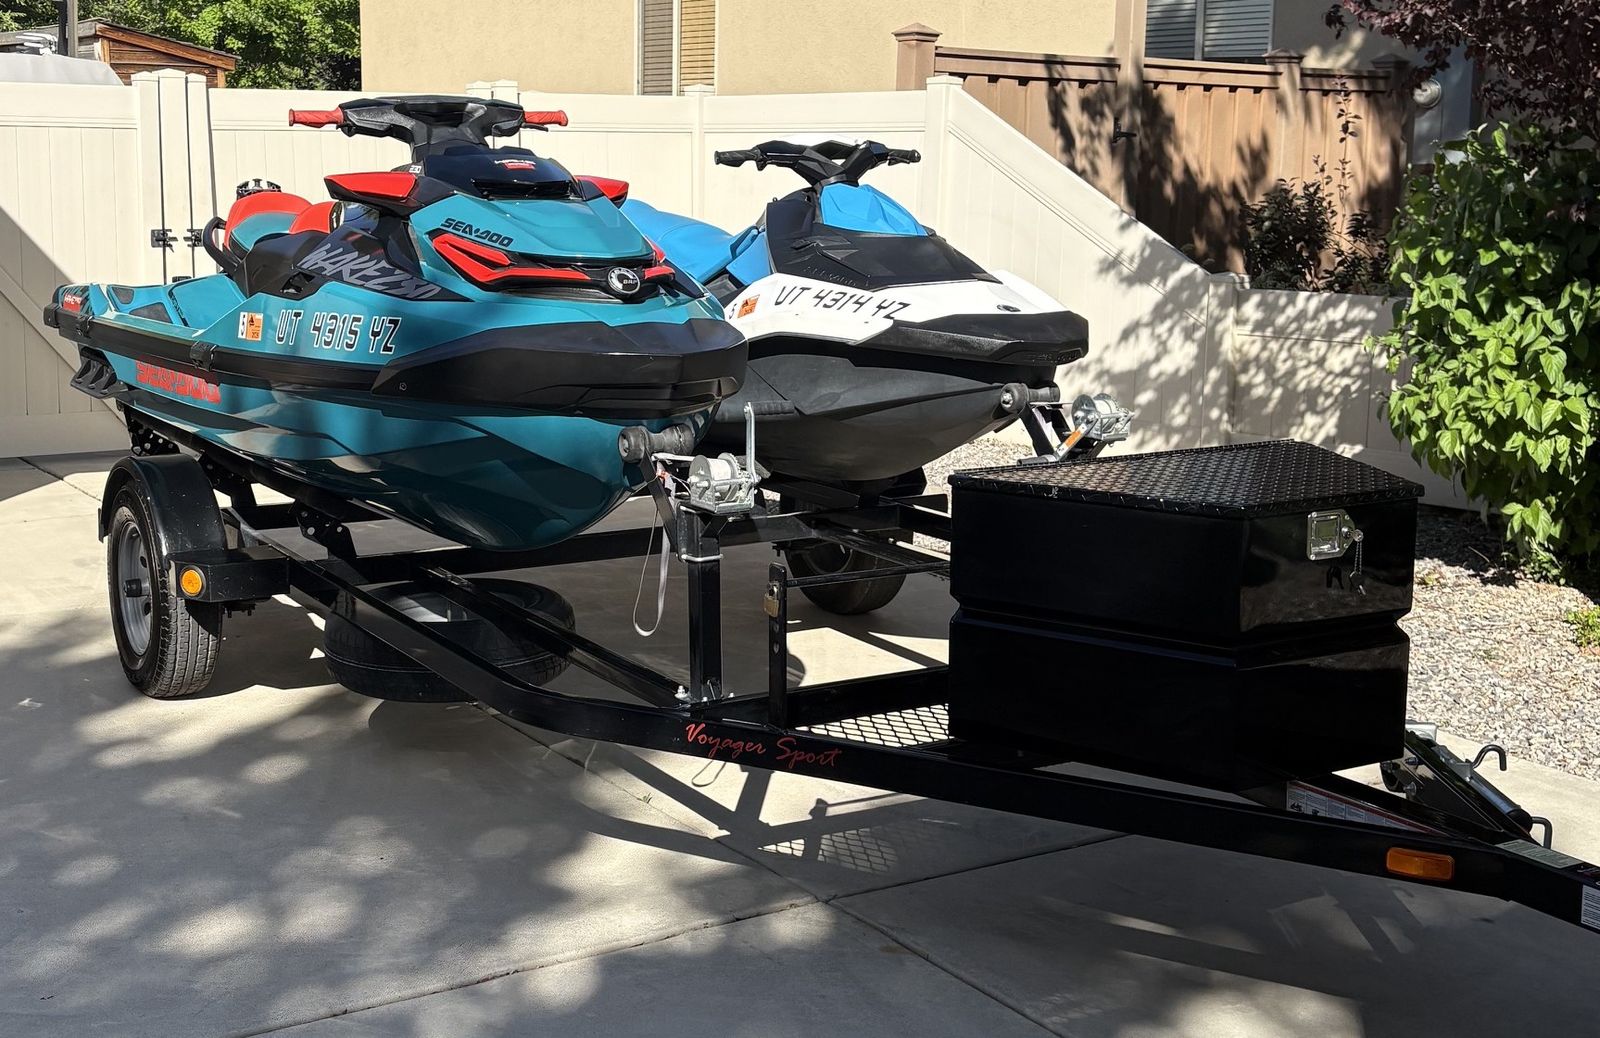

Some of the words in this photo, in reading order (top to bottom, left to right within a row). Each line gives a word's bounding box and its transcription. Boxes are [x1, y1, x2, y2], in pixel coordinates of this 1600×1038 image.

[774, 286, 811, 306] UT
[813, 288, 873, 313] 4314
[871, 299, 911, 320] YZ
[276, 304, 304, 345] UT
[310, 311, 364, 351] 4315
[369, 316, 402, 354] YZ
[686, 723, 766, 759] Voyager
[776, 737, 843, 769] Sport
